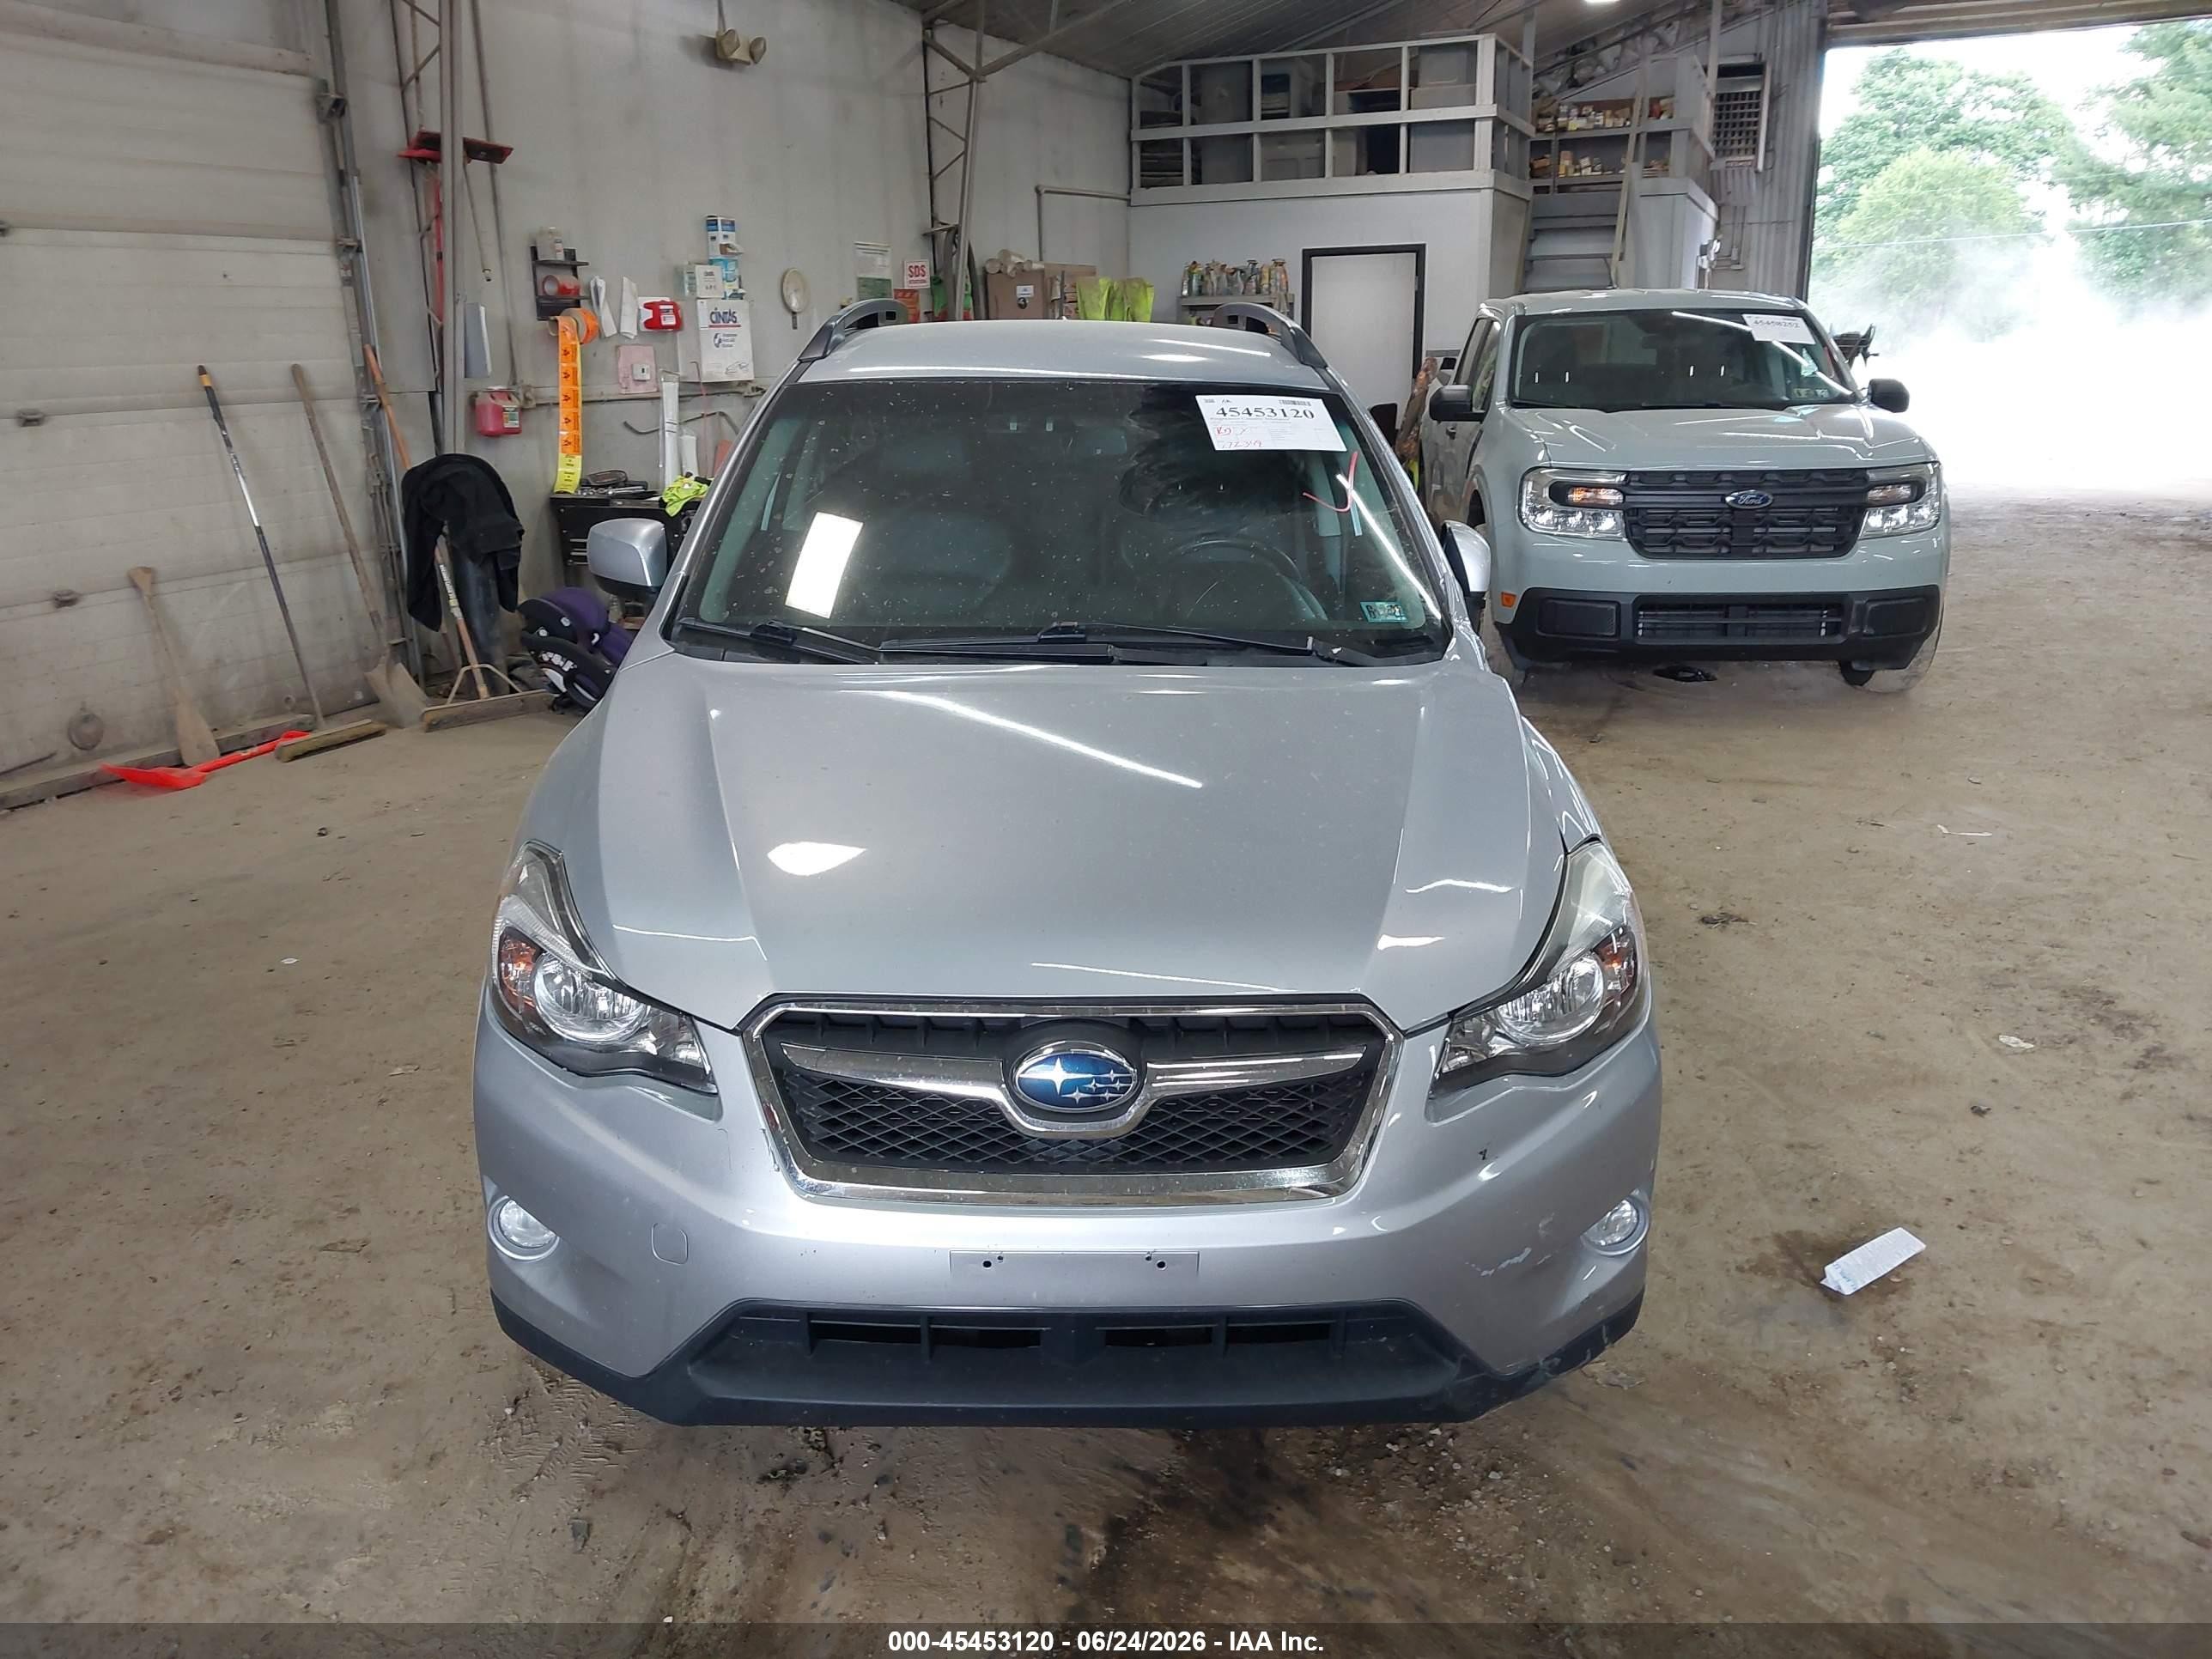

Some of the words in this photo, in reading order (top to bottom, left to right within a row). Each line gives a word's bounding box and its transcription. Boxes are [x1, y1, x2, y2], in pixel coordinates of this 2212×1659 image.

[908, 264, 927, 277] SDS
[709, 307, 738, 324] CINTAS
[1216, 407, 1315, 420] 45453120
[1738, 494, 1768, 505] Ford
